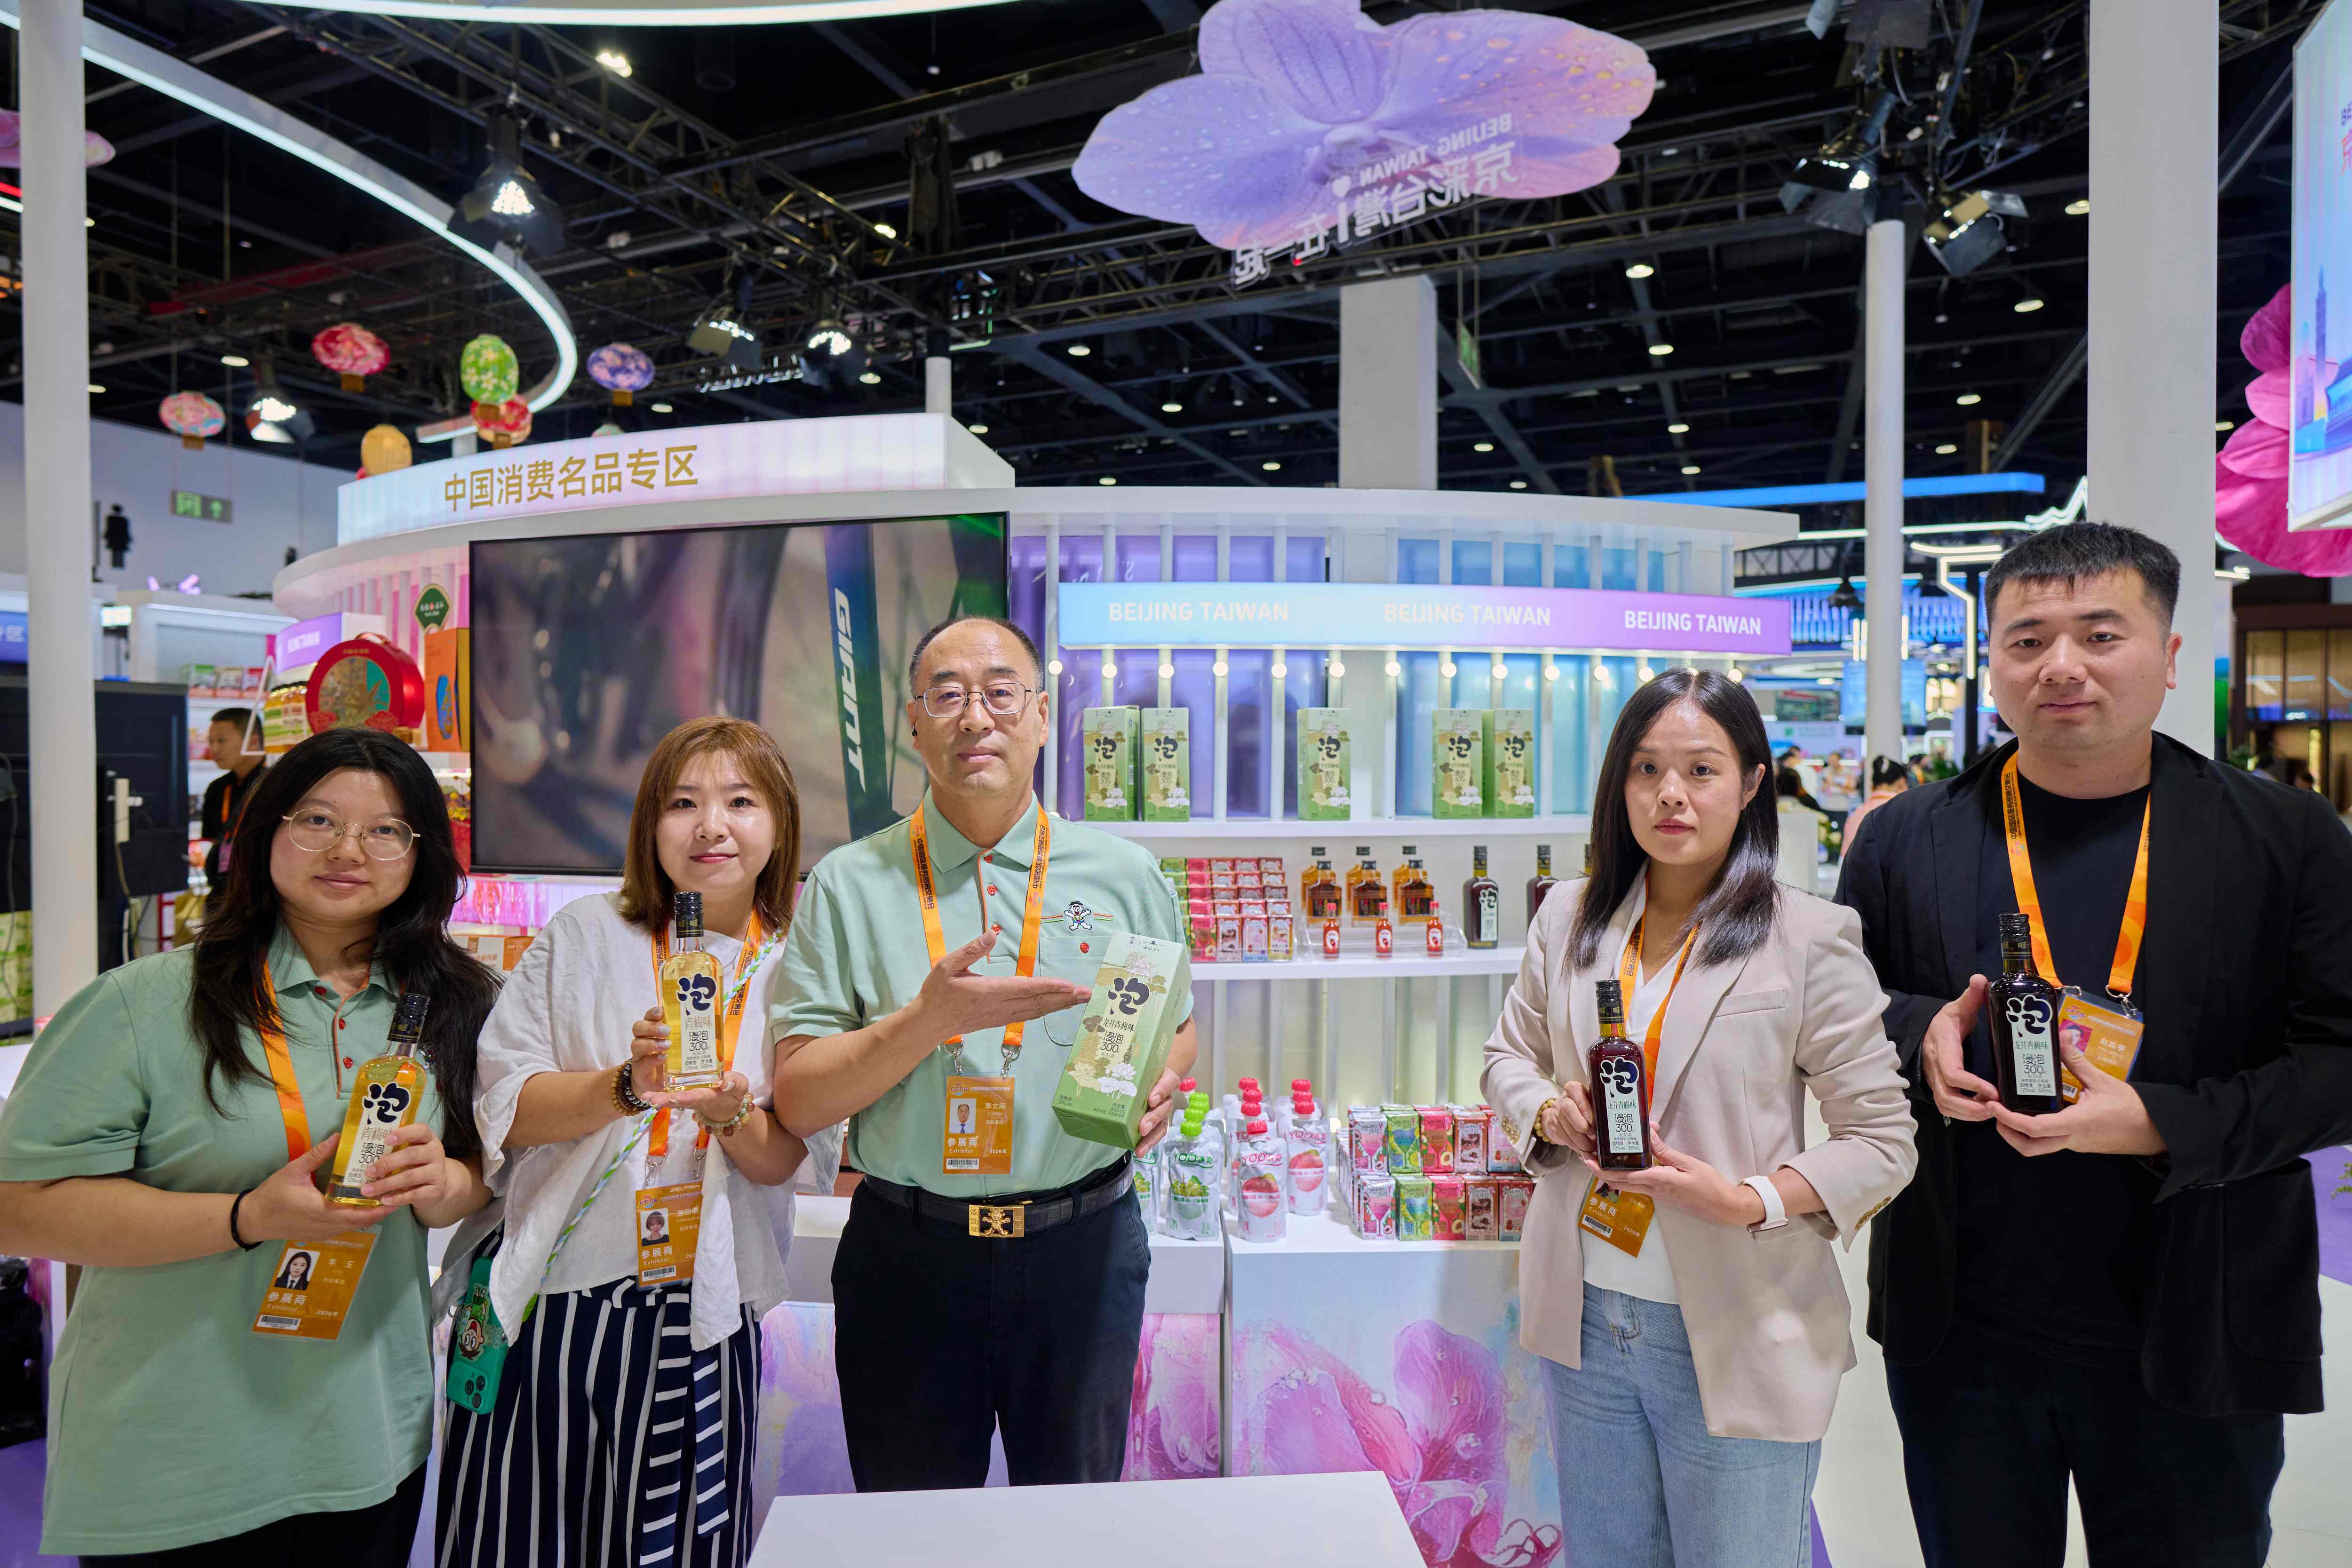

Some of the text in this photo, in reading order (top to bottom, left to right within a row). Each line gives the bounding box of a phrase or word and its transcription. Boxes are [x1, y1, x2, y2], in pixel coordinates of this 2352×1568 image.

[445, 445, 698, 512] 中国消费名品专区
[1109, 602, 1289, 622] BEIJING TAIWAN
[1384, 604, 1550, 626] BEIJING TAIWAN
[1624, 610, 1761, 636] BEIJING TAIWAN
[834, 587, 866, 793] GIANT
[677, 973, 716, 1016] 泡
[1108, 978, 1150, 1015] 泡
[685, 1016, 713, 1031] 青梅味
[2006, 995, 2052, 1038] 泡
[1103, 1018, 1135, 1033] 龙井青梅味
[689, 1031, 709, 1042] 浸泡
[1103, 1031, 1124, 1044] 浸泡
[2015, 1040, 2049, 1050] 龙井青梅味
[2023, 1054, 2044, 1066] 浸泡
[1600, 1058, 1639, 1098] 泡
[364, 1082, 410, 1125] 泡
[1607, 1100, 1637, 1109] 龙井青梅味
[1614, 1113, 1633, 1124] 浸泡
[361, 1141, 384, 1155] 浸泡
[947, 1137, 978, 1147] 参展商
[1588, 1206, 1611, 1220] Exhibitor
[1589, 1196, 1618, 1217] 参展商
[641, 1246, 673, 1259] 参展商
[644, 1257, 670, 1266] Exhibitor
[268, 1291, 307, 1305] 参展商
[267, 1304, 298, 1312] Exhibitor
